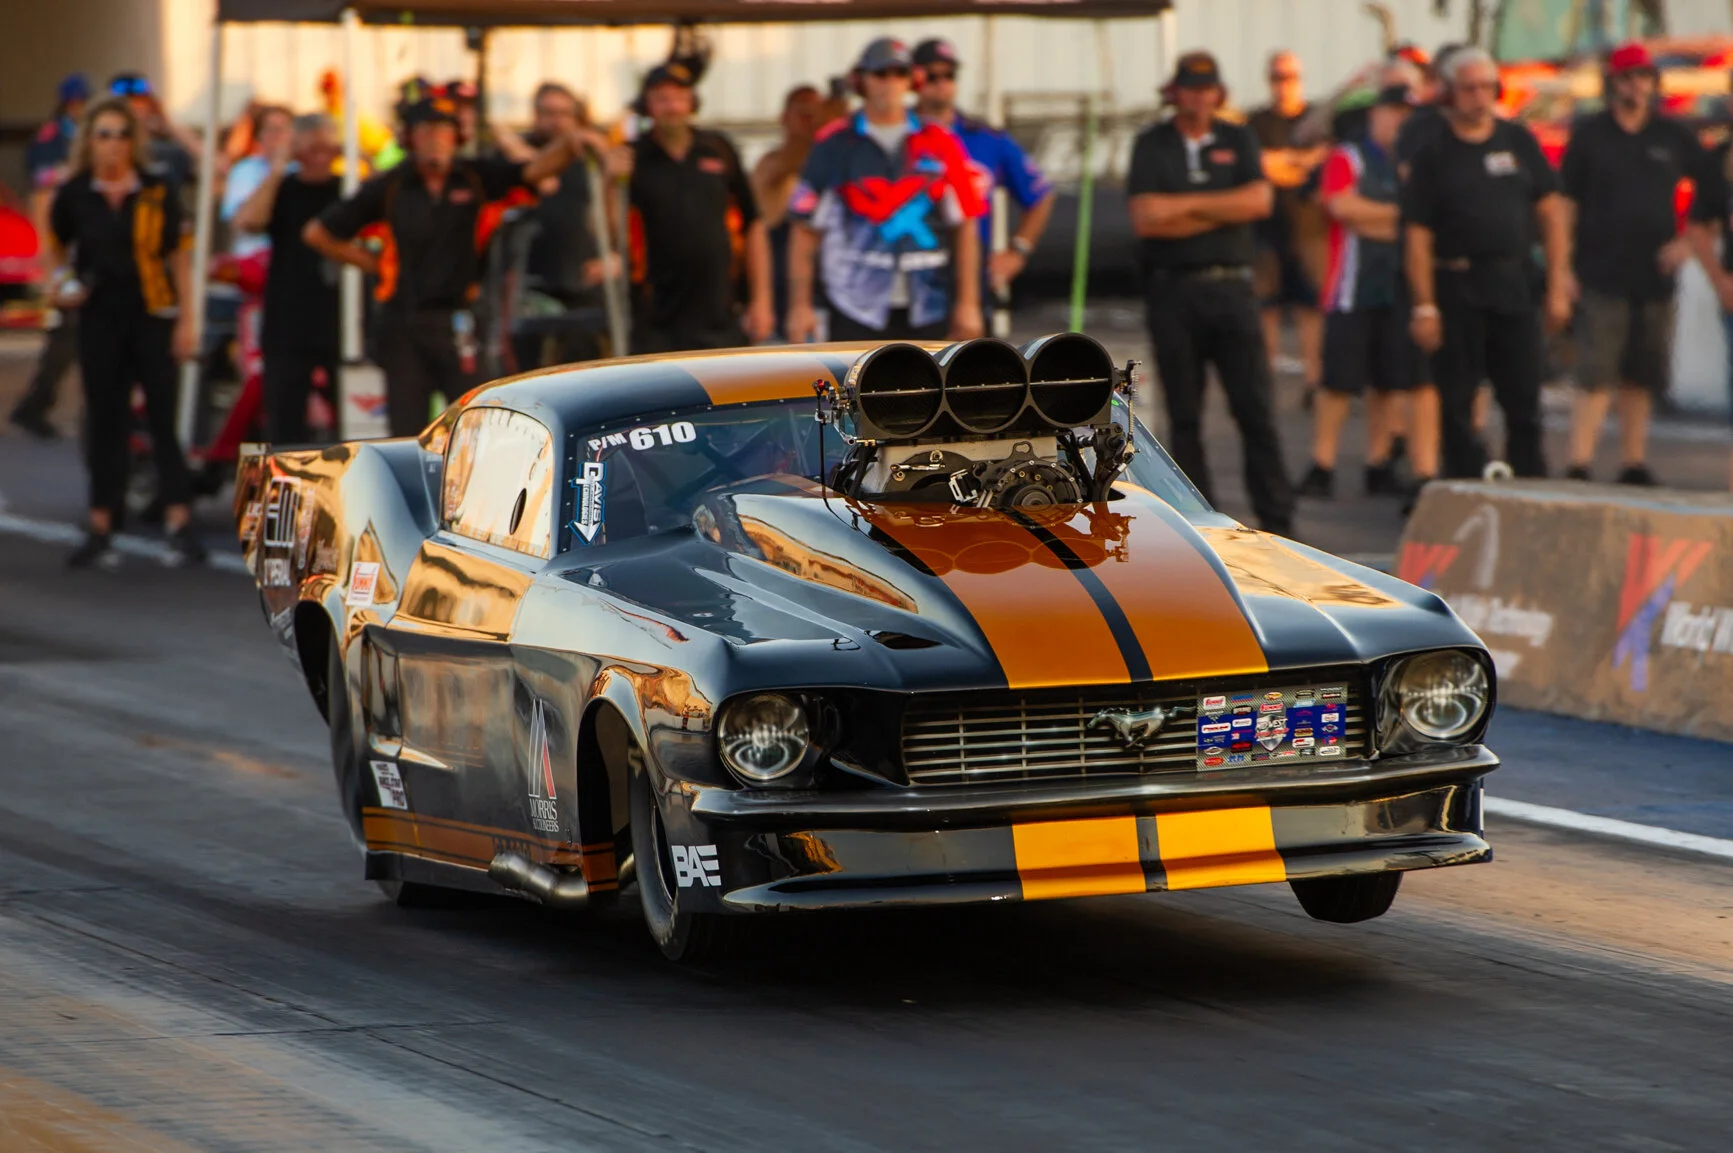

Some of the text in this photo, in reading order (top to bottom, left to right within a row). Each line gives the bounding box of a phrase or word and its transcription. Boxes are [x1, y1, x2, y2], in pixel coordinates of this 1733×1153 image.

[587, 421, 697, 452] P/M 610
[529, 798, 558, 820] MORRIS
[671, 844, 722, 887] BAE
